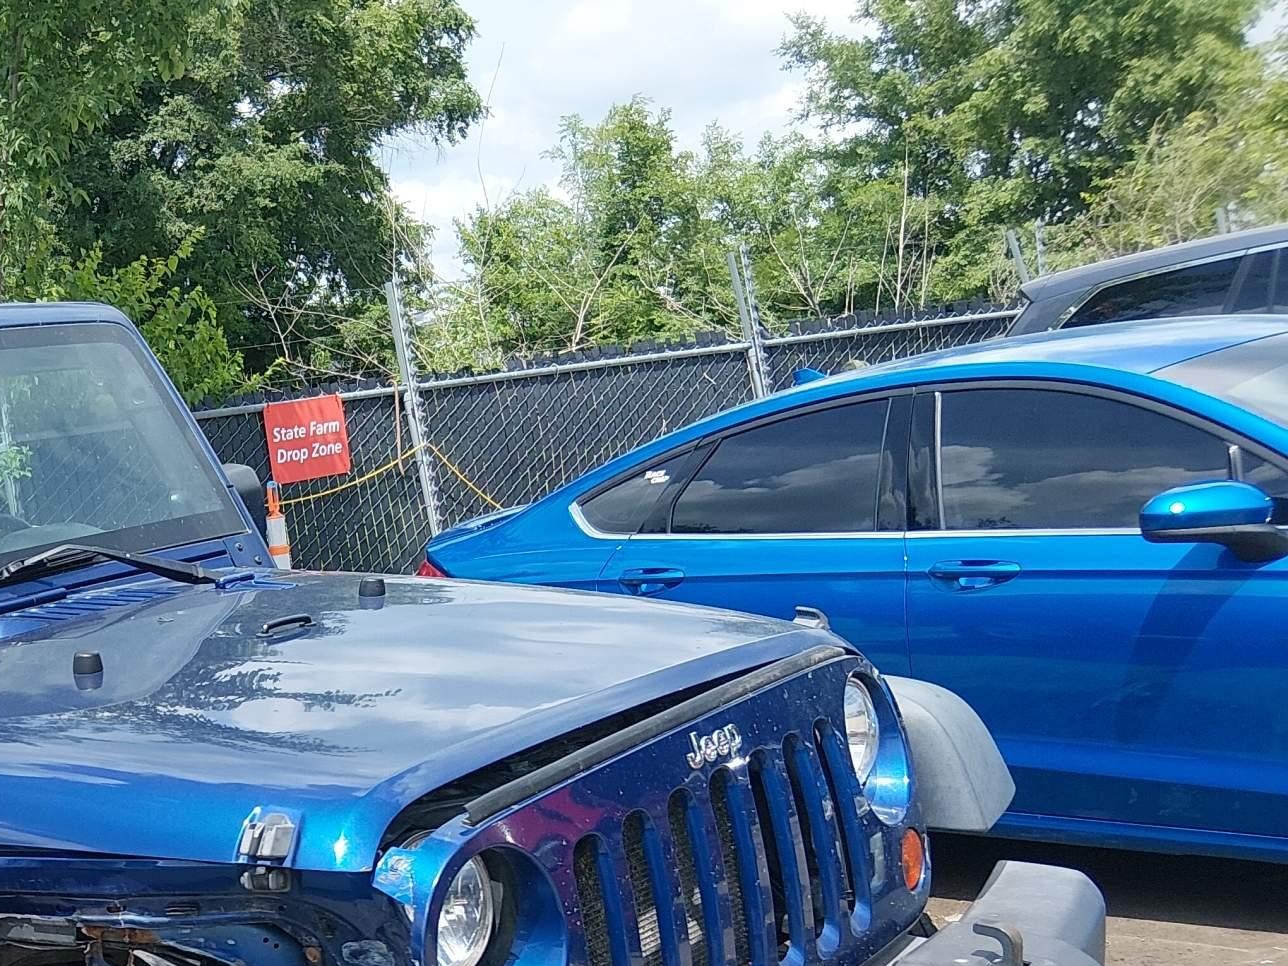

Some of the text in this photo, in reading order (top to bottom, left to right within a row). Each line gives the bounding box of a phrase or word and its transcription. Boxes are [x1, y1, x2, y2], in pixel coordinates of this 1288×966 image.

[273, 420, 340, 442] State Farm
[277, 442, 343, 464] Drop Zone
[686, 723, 743, 769] Jeep
